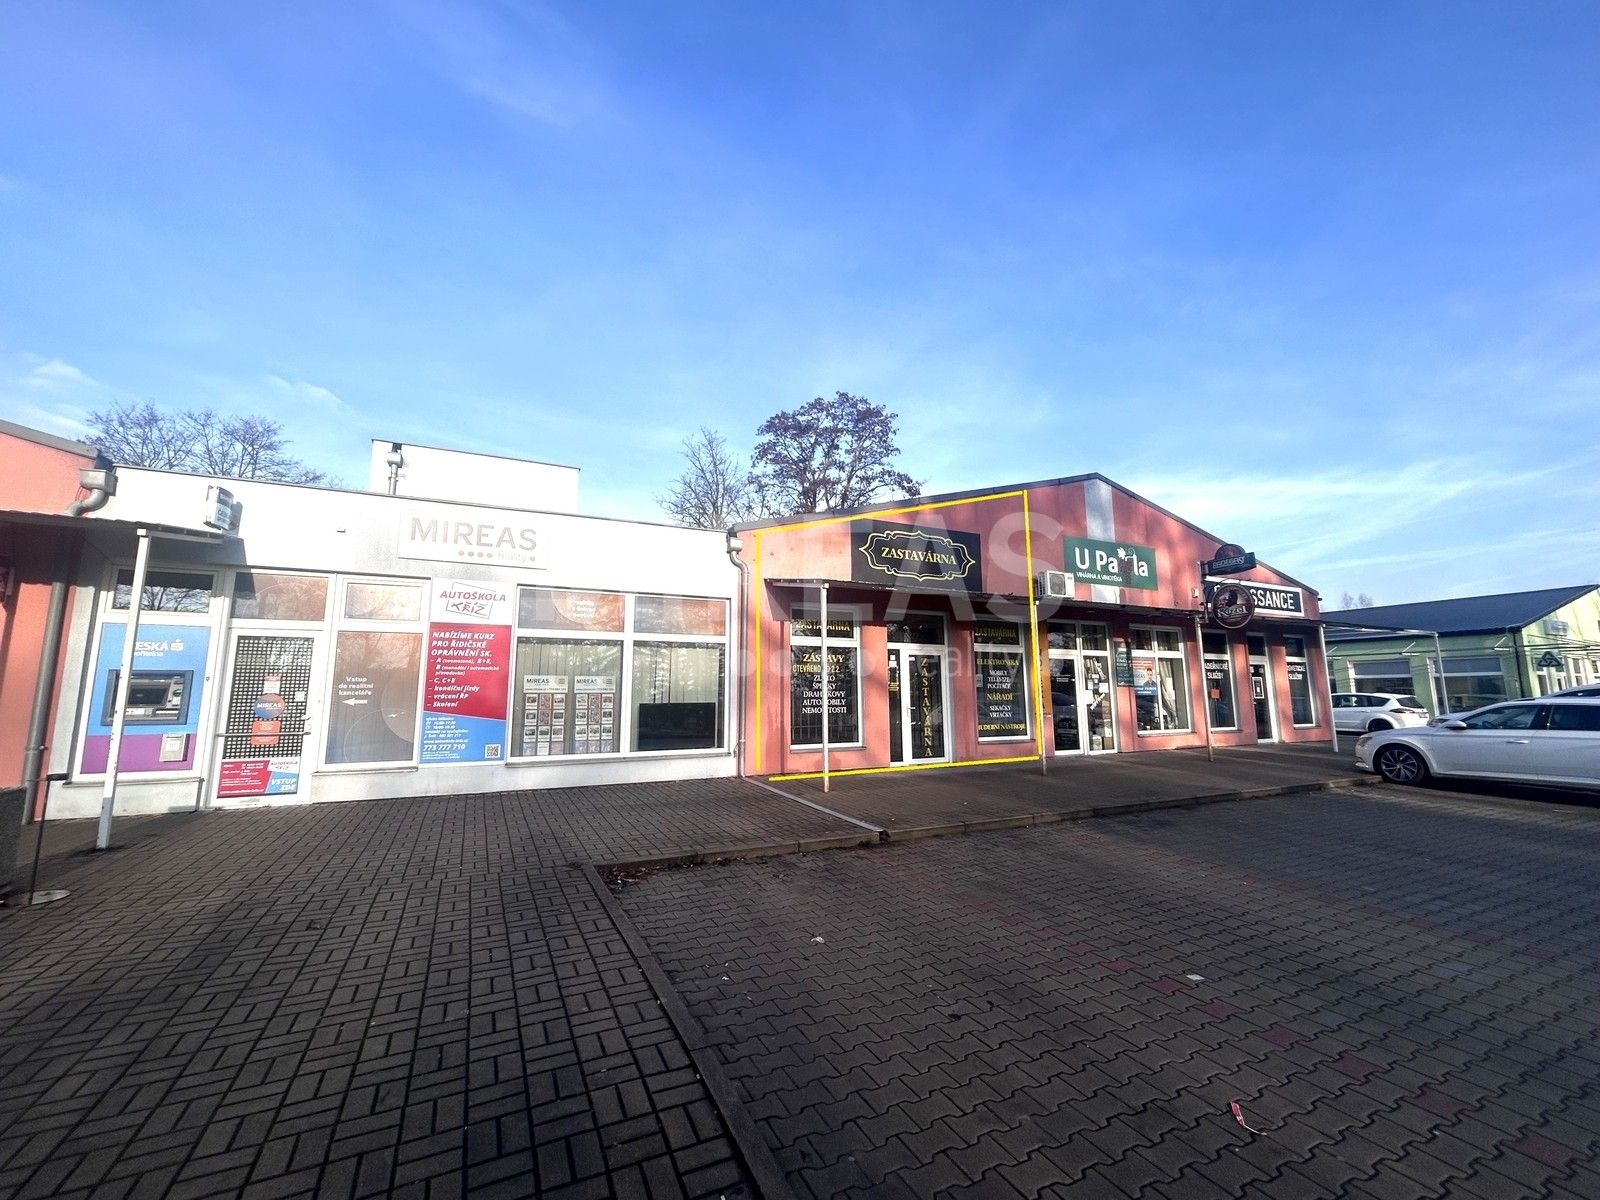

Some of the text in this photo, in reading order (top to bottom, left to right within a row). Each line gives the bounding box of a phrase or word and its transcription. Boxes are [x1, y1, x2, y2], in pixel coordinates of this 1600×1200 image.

[410, 517, 537, 551] MIREAS
[881, 546, 957, 565] ZASTAVÁRNA
[1074, 546, 1149, 577] U Pala
[440, 590, 507, 602] AUTOŠKOLA
[451, 601, 487, 616] KŘÍŽ
[1217, 605, 1249, 617] Kozel
[794, 619, 850, 631] ZASTAÁRNA
[432, 631, 495, 640] NABÍZÍME KURZ
[135, 640, 169, 651] ESKÁ
[450, 640, 487, 649] ŘIDIČSKÉ
[431, 649, 479, 657] OPRÁVNĚNÍ
[803, 653, 845, 663] ZÁSAVY
[977, 658, 1019, 666] ELEKTRONIKA
[793, 664, 822, 673] OTEVŘENO
[1204, 661, 1229, 670] ADEŘNICKÉ
[463, 685, 480, 693] jízdy
[812, 681, 837, 689] ŠPKY
[803, 690, 823, 698] DRAH
[986, 692, 1013, 701] NÁŘADÍ
[802, 698, 846, 706] AUTOOBILY
[920, 657, 933, 757] ZASTAVÁRNA
